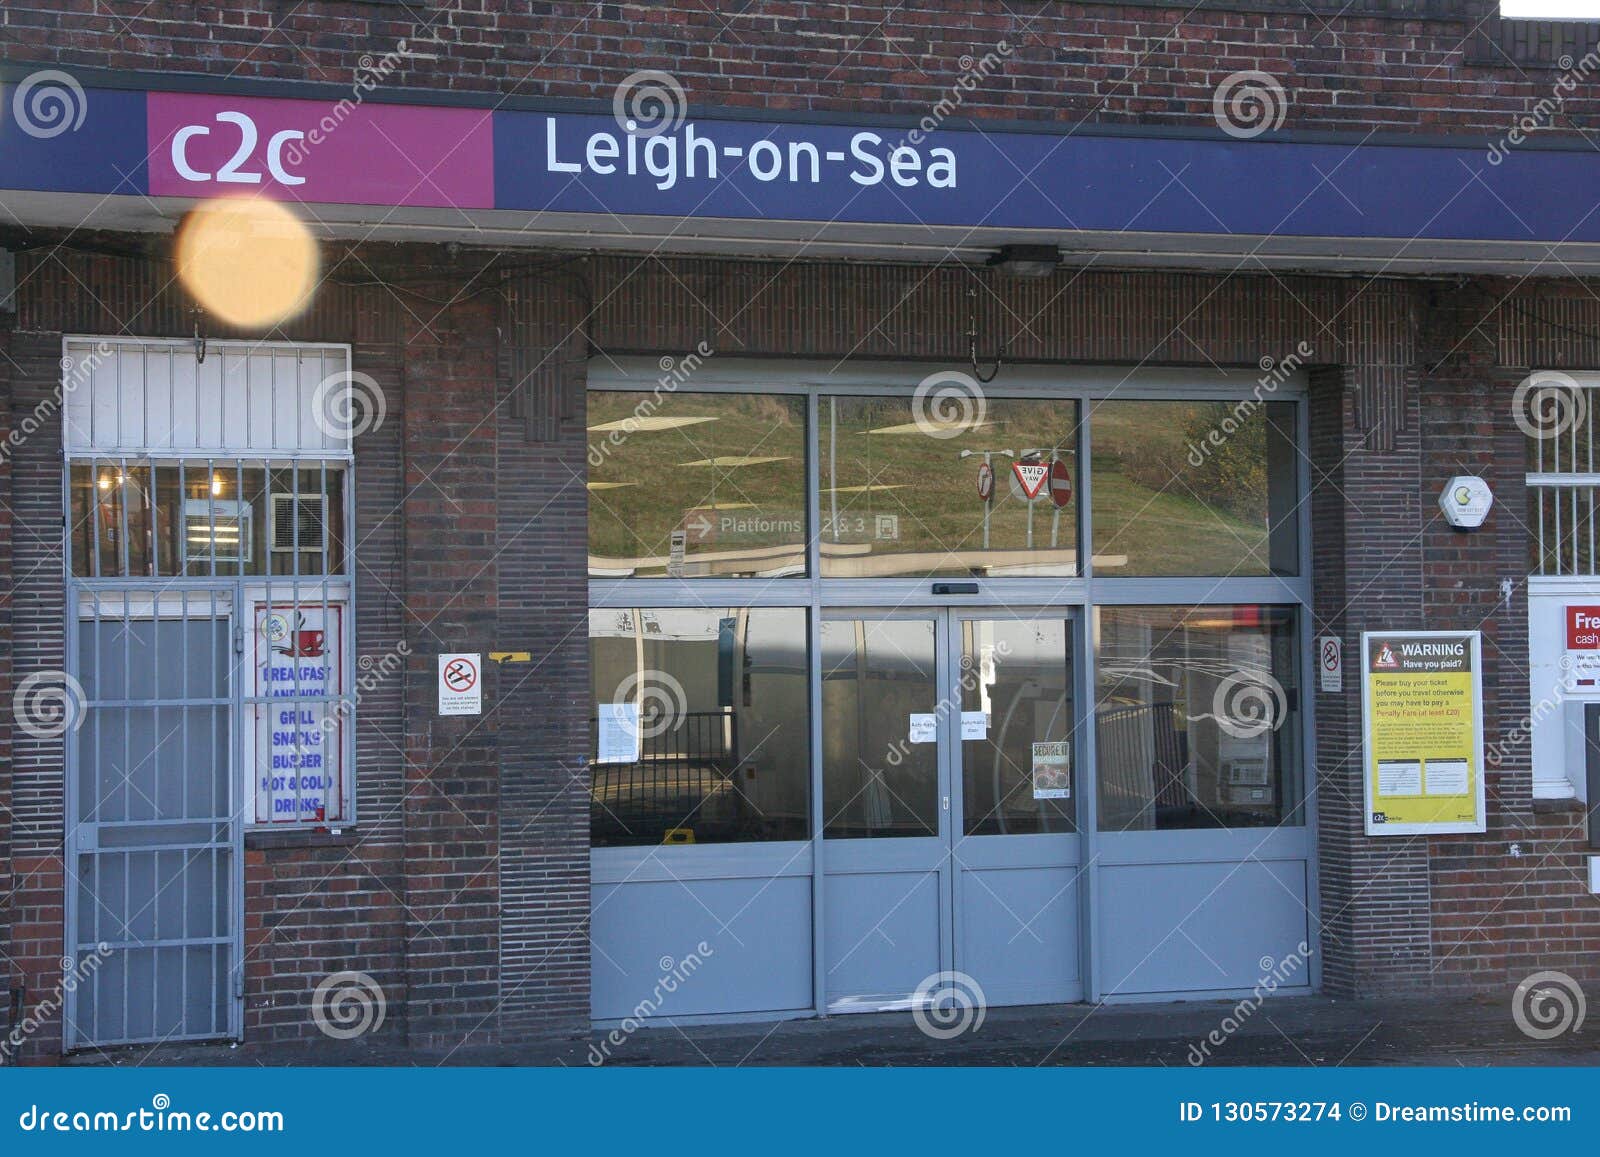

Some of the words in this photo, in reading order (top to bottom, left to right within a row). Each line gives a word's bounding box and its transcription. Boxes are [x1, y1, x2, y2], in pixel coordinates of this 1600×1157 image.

[171, 111, 305, 185] c2c
[547, 118, 957, 190] Leigh-on-Sea
[721, 517, 801, 533] Platforms
[838, 518, 849, 533] &
[855, 518, 865, 533] 3
[1575, 633, 1599, 644] cash
[1401, 643, 1464, 656] WARNING
[1404, 660, 1423, 668] Have
[1425, 661, 1439, 670] you
[1441, 660, 1463, 669] paid?
[280, 710, 315, 725] GRLL
[1377, 709, 1400, 718] Penalty
[288, 777, 298, 790] &
